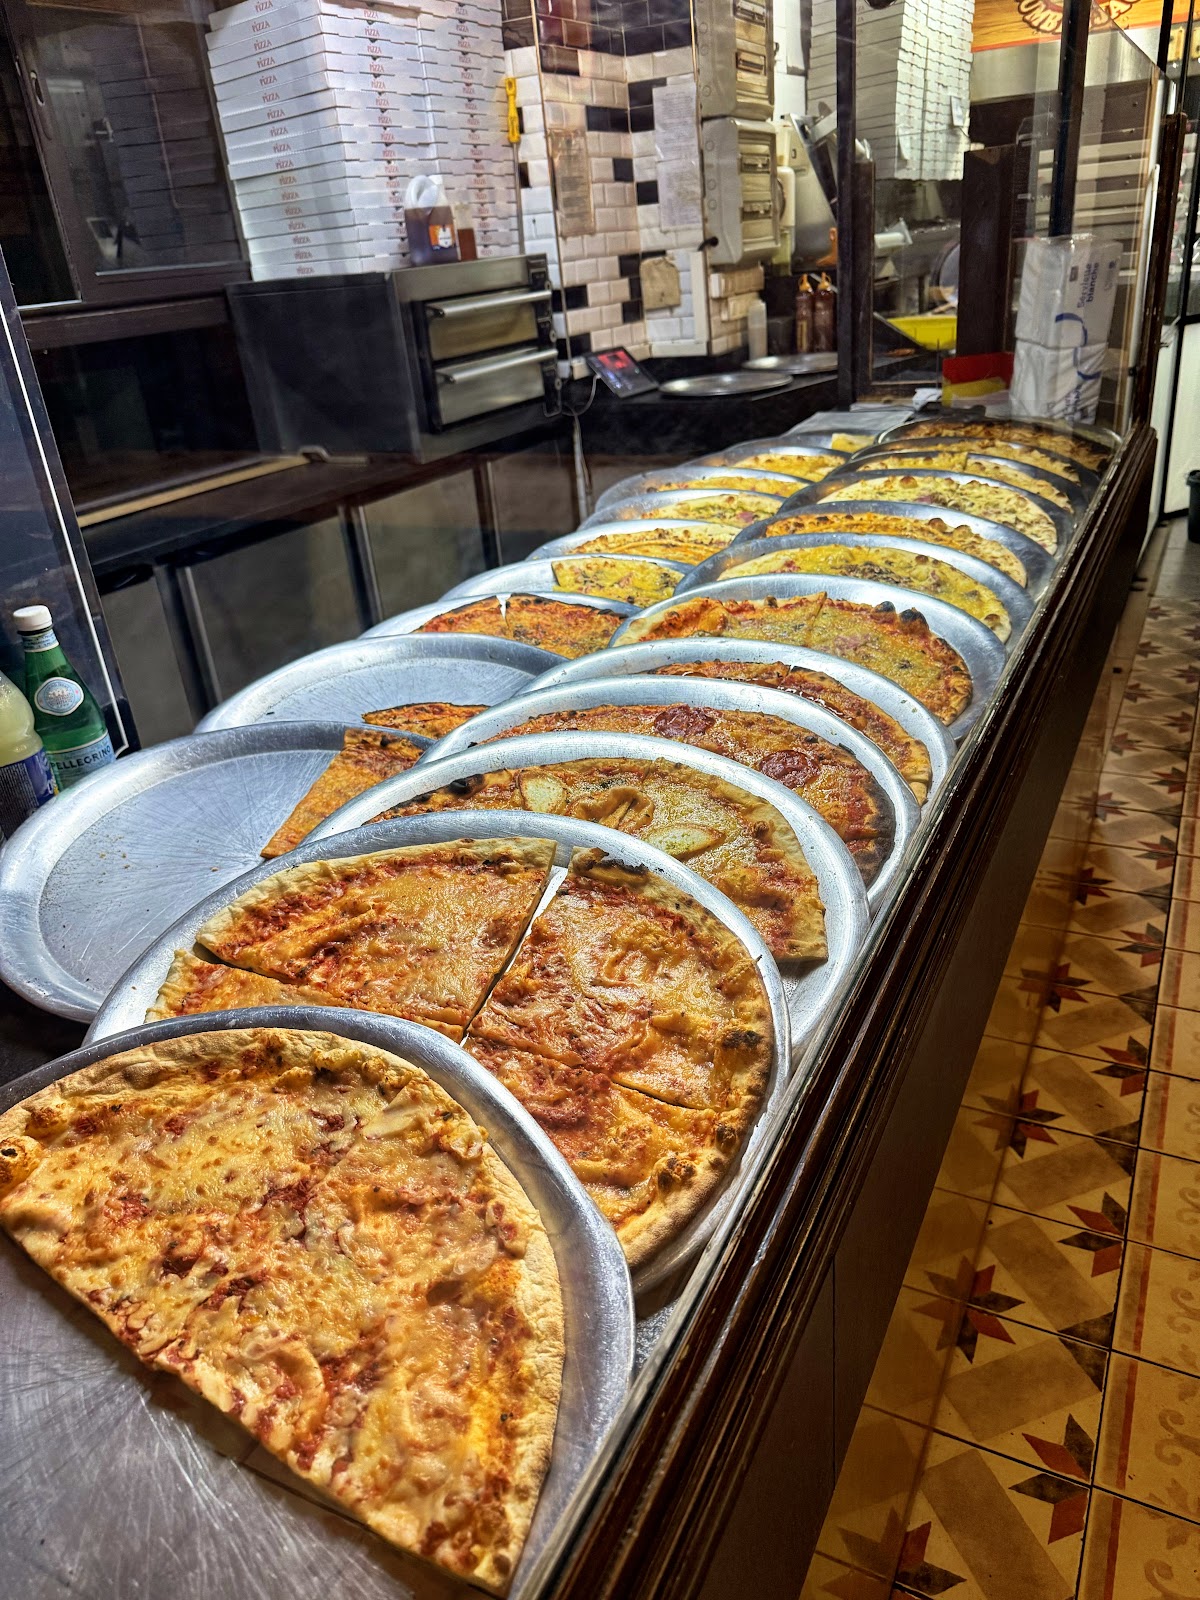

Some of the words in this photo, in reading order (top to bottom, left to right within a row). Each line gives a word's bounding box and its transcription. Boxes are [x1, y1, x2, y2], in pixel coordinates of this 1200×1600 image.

[255, 0, 273, 12] PIZZA
[363, 9, 379, 18] PIZZA
[251, 20, 271, 32] PIZZA
[364, 26, 380, 37] PIZZA
[253, 40, 272, 51] PIZZA
[367, 44, 382, 54] PIZZA
[256, 57, 275, 68] PIZZA
[369, 61, 385, 72] PIZZA
[259, 75, 277, 86] PIZZA
[371, 80, 386, 89] PIZZA
[262, 93, 280, 103] PIZZA
[375, 96, 390, 106] PIZZA
[267, 109, 286, 119] PIZZA
[378, 115, 393, 124] PIZZA
[270, 126, 288, 137] PIZZA
[273, 143, 291, 153] PIZZA
[275, 159, 294, 169] PIZZA
[50, 745, 111, 770] PELLEGRINO
